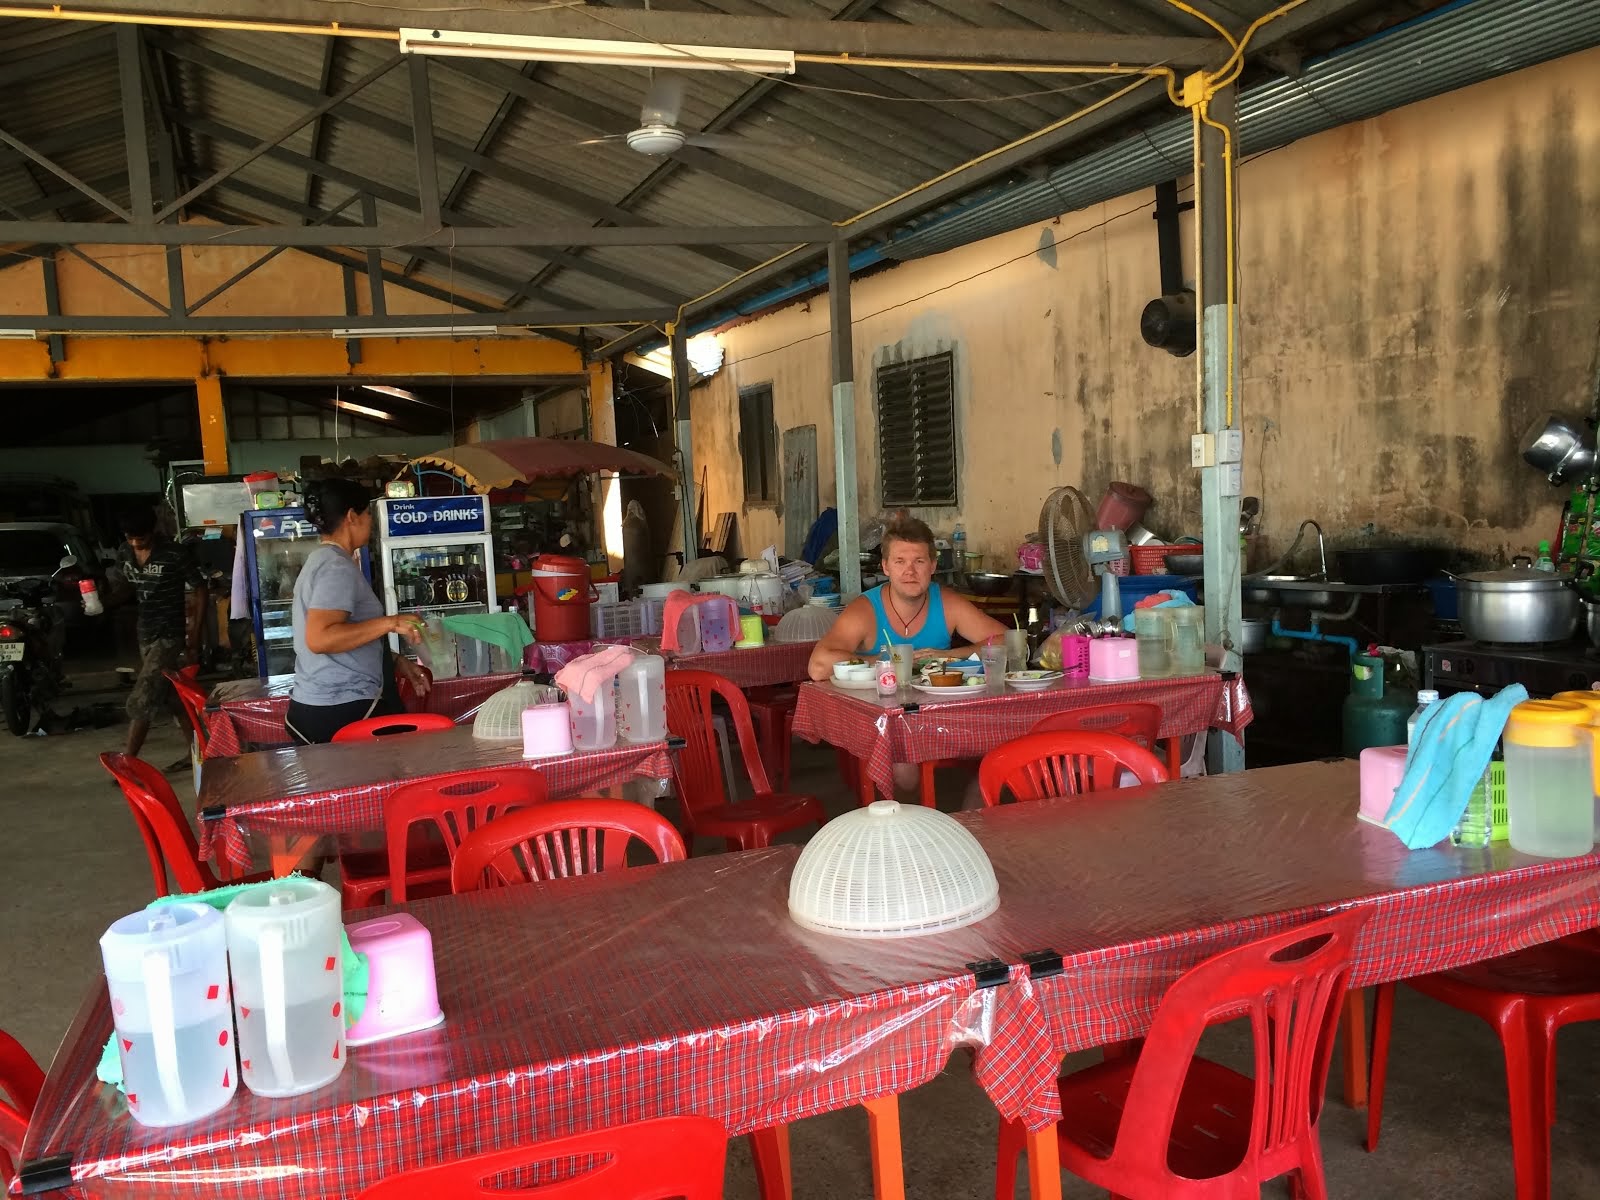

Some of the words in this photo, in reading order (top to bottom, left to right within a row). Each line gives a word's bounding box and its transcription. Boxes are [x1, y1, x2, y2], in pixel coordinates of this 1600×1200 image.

[393, 503, 415, 511] Drink
[392, 511, 428, 524] COLD
[433, 508, 479, 522] DRINKS
[280, 519, 316, 534] PE
